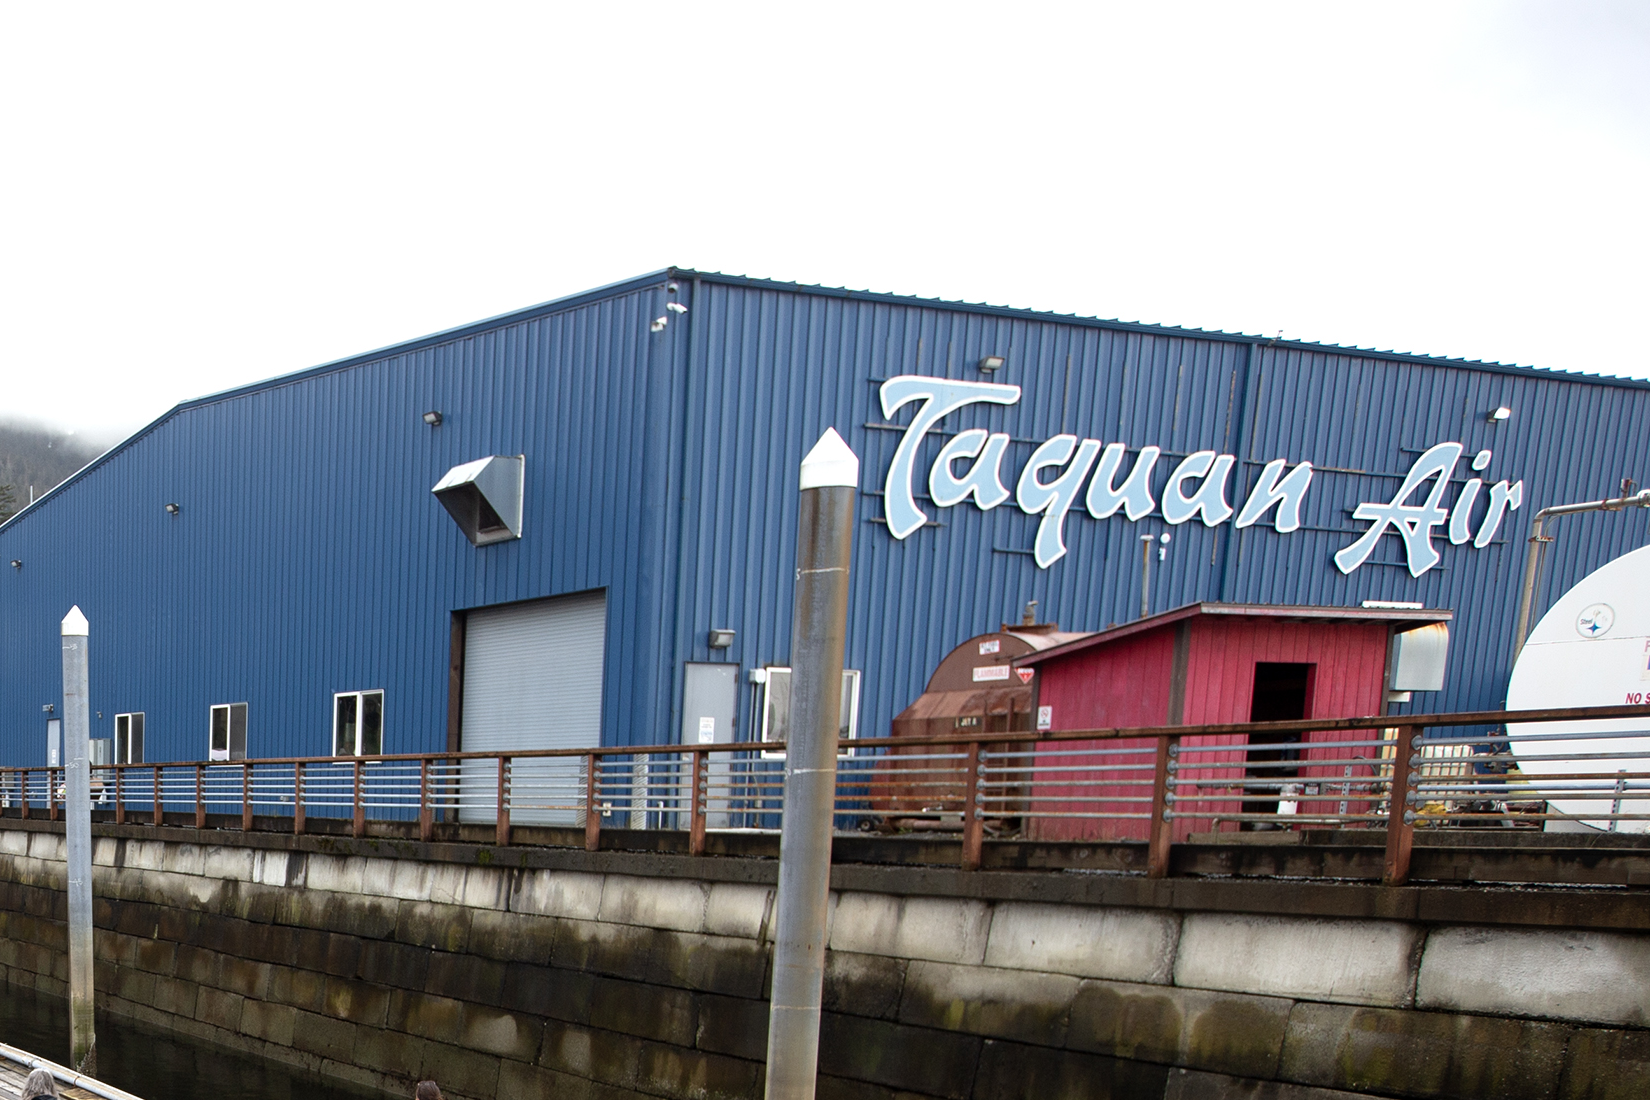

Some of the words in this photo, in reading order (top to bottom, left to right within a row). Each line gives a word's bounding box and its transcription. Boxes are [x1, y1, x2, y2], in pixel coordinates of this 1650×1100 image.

[879, 375, 1313, 569] Taquan
[1334, 442, 1522, 578] Air
[1580, 618, 1593, 626] Steel
[1625, 693, 1642, 704] NO
